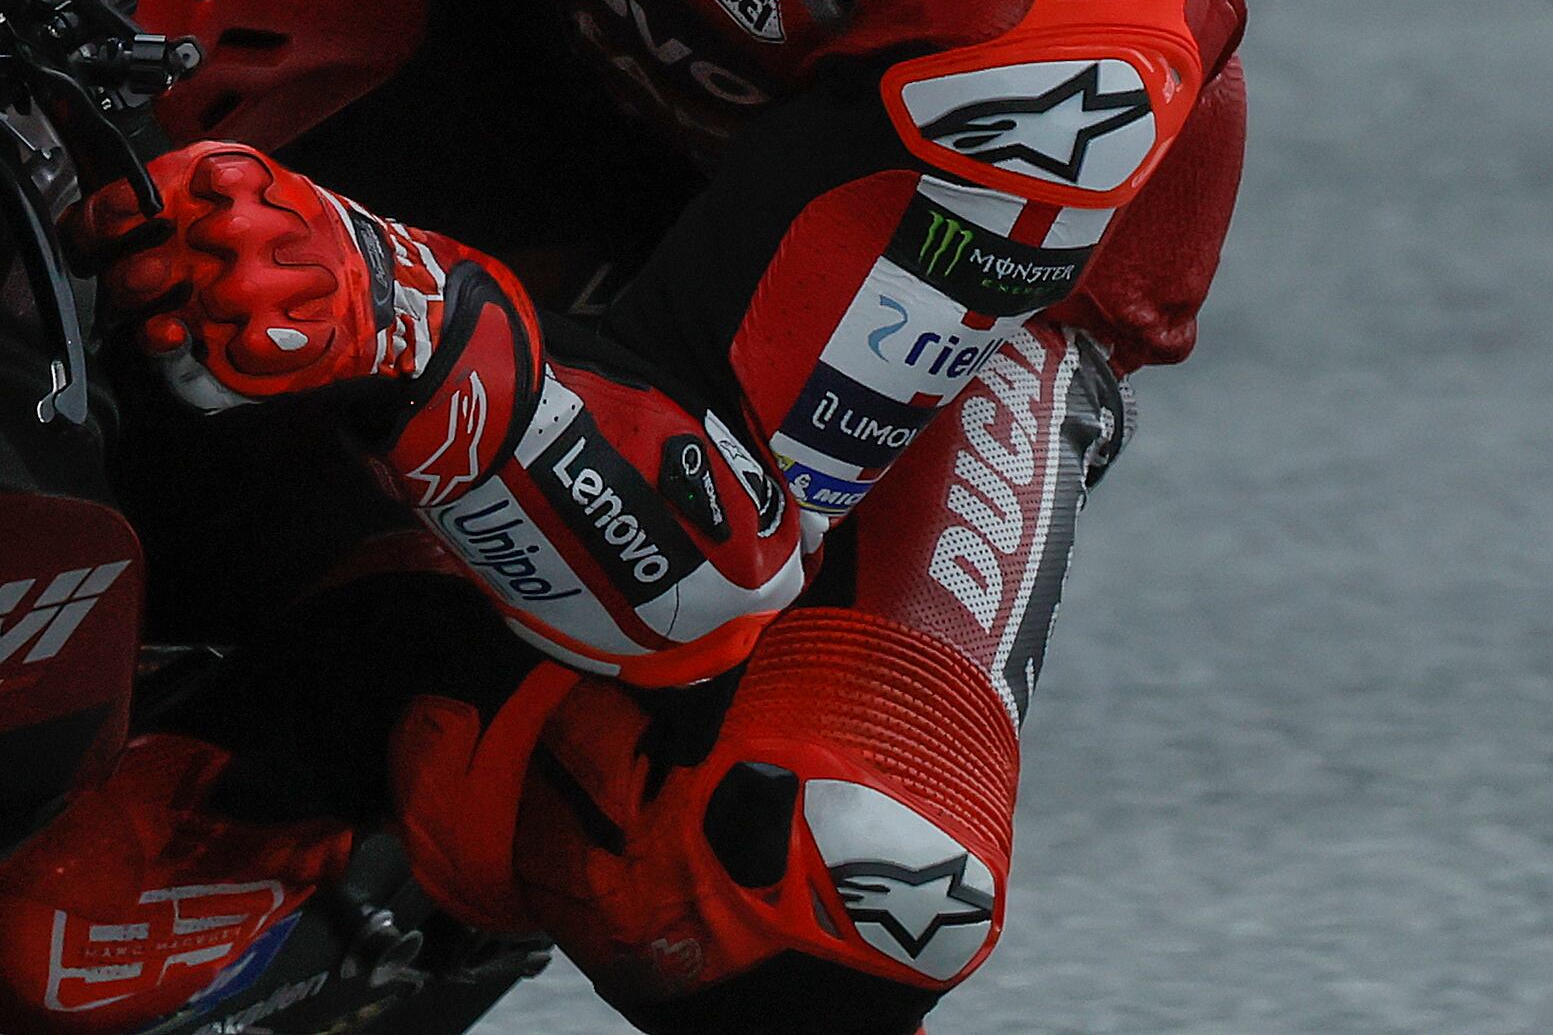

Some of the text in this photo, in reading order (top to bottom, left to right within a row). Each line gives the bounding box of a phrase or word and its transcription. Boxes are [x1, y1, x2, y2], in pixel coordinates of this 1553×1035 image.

[904, 331, 1005, 379] riell
[454, 498, 585, 603] Unipol
[553, 436, 670, 584] Lenovo
